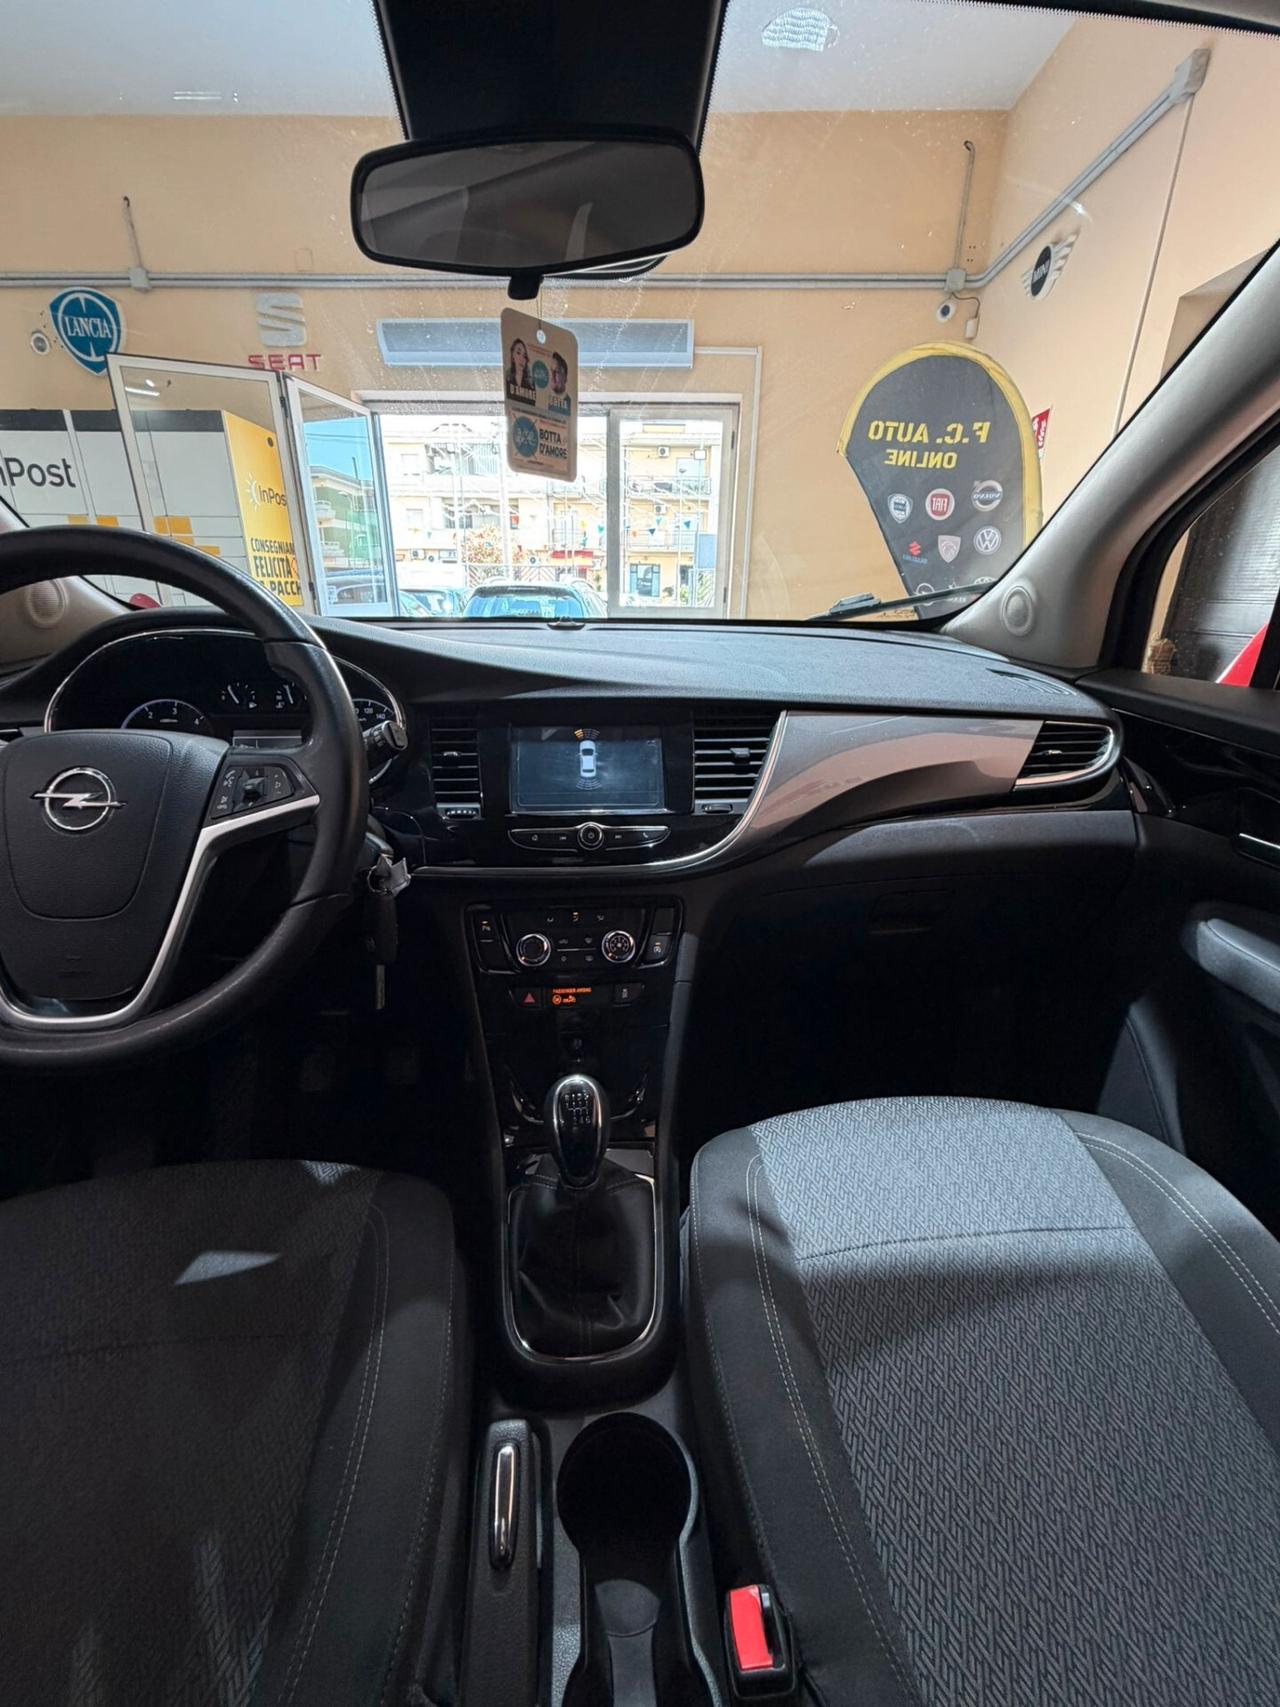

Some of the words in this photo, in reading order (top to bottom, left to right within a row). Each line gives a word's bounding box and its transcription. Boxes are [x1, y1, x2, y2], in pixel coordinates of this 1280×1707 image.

[64, 316, 112, 338] LANCIA
[248, 353, 321, 371] SEAT
[539, 429, 562, 444] BOTTA
[539, 443, 568, 460] D'AMORE
[258, 485, 288, 507] InPos
[250, 537, 295, 555] CONSEGNIA
[254, 555, 293, 578] FELICITÀ
[269, 580, 302, 597] PACCH
